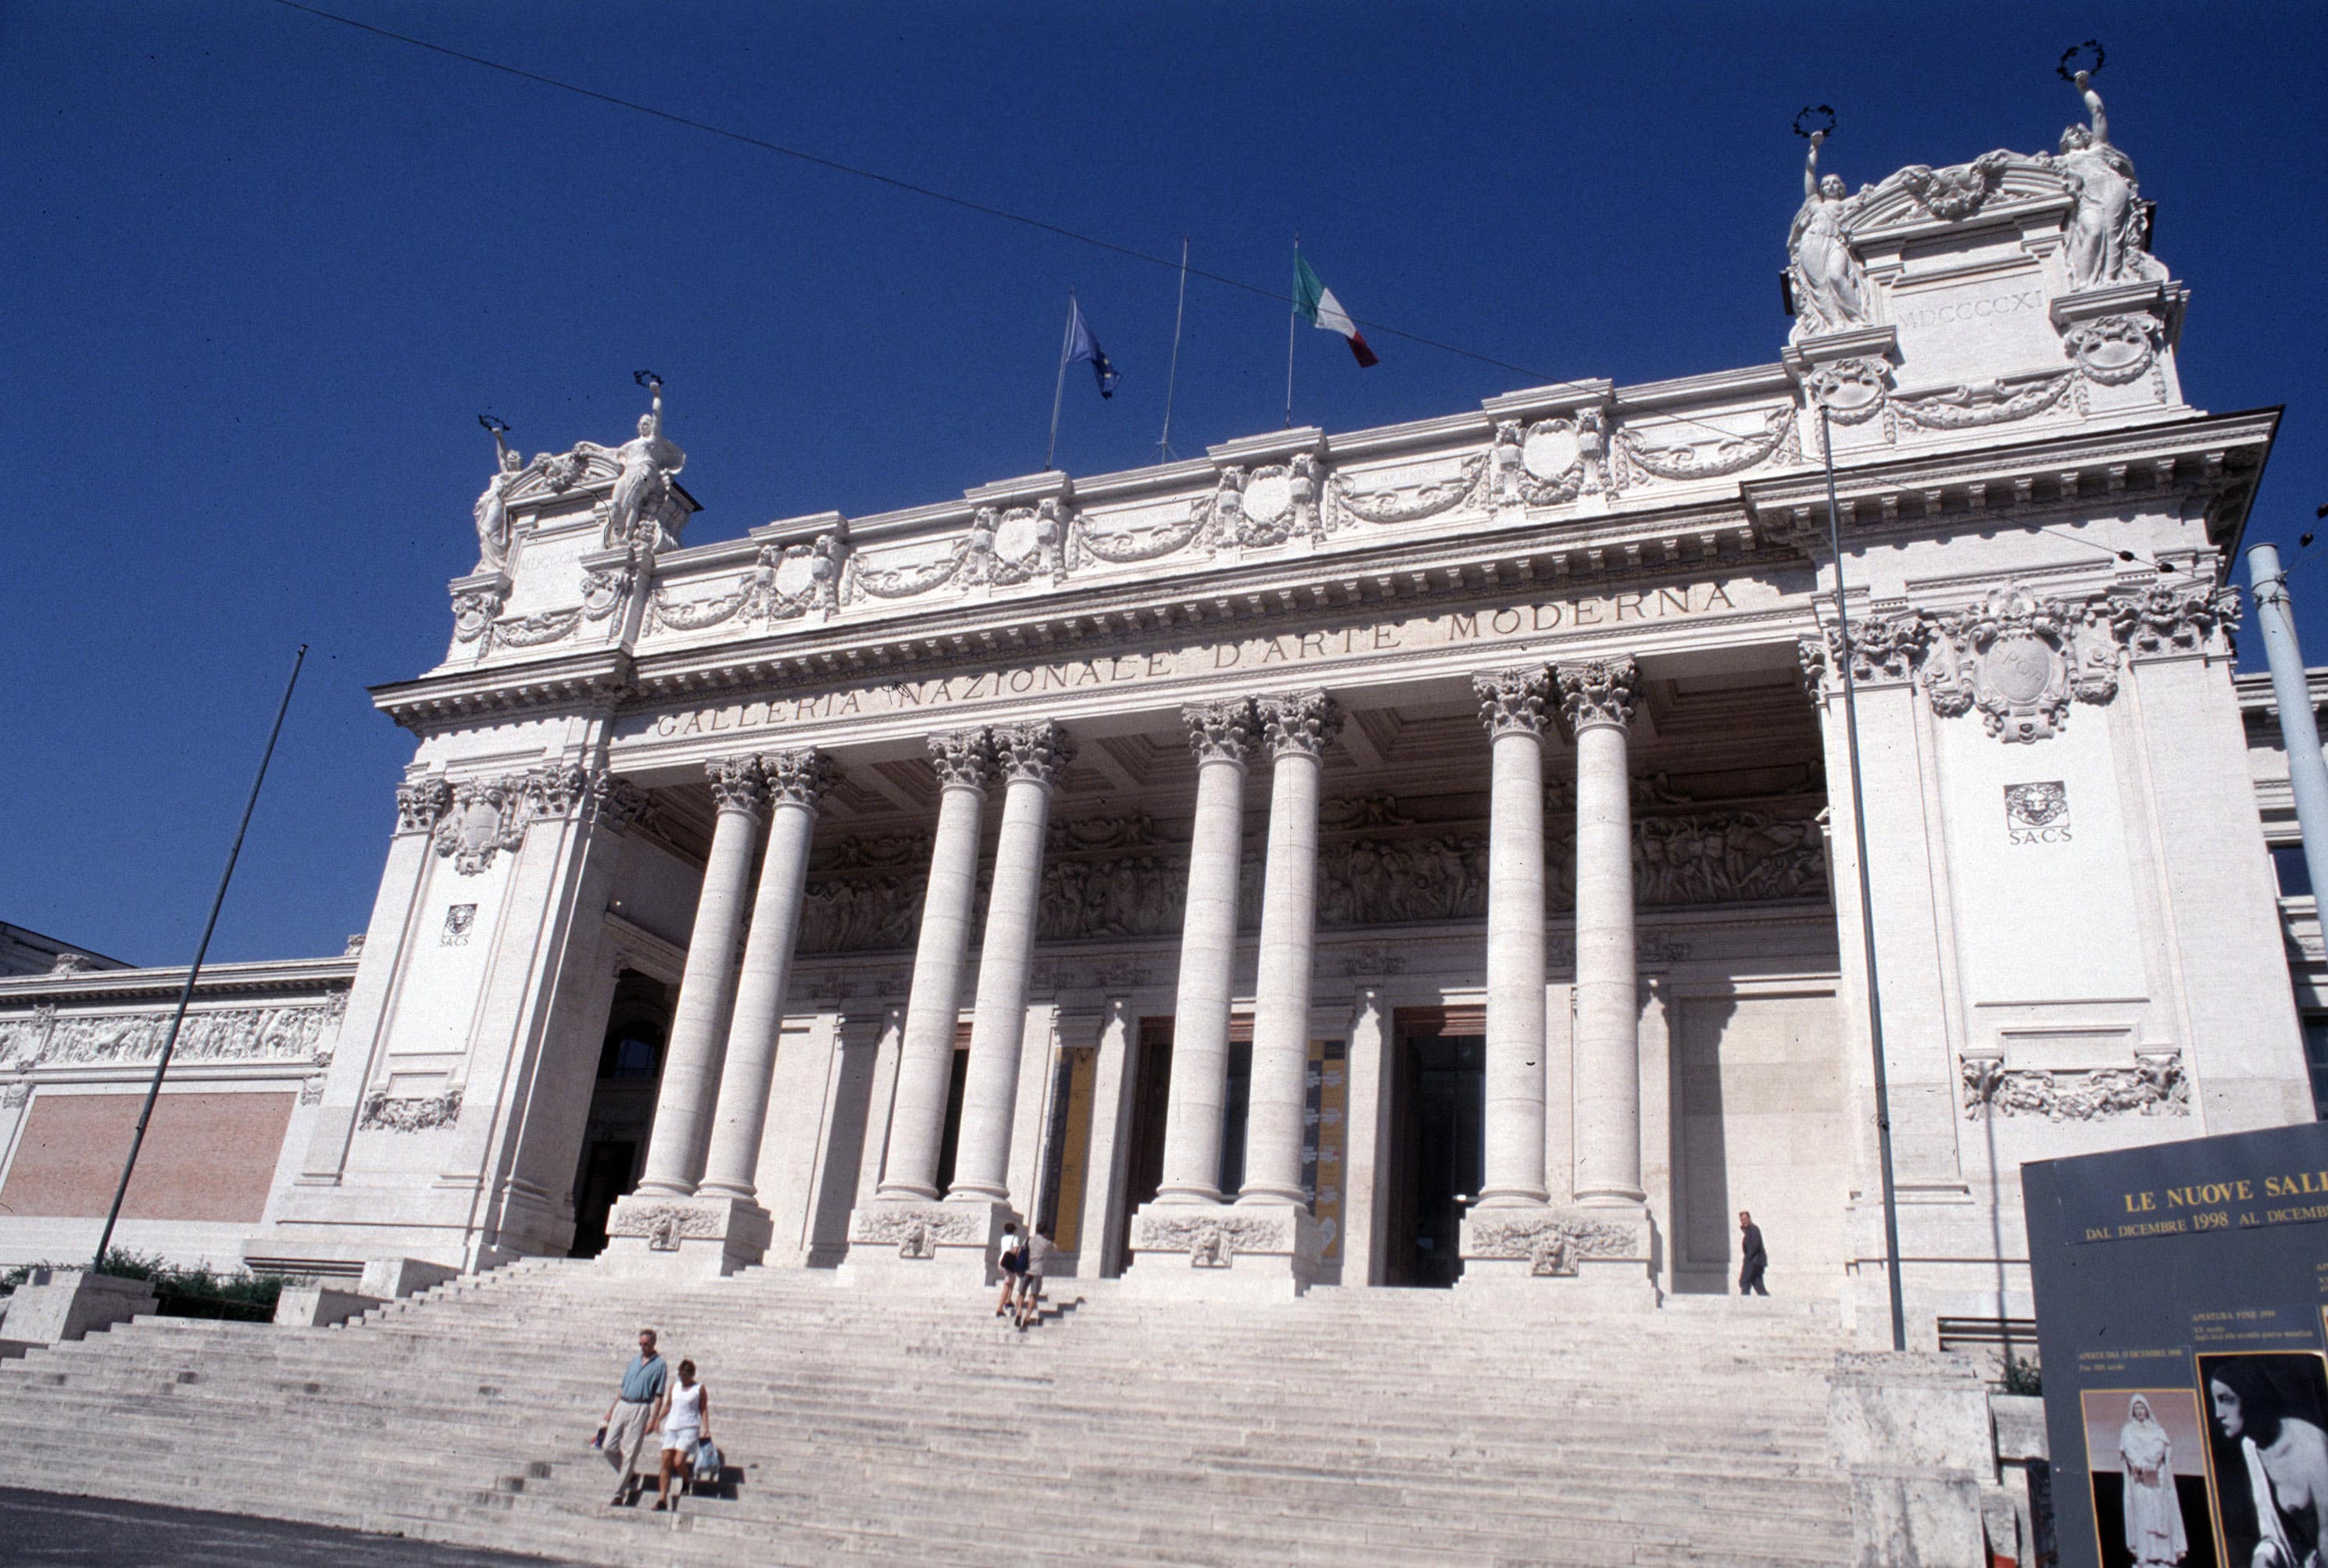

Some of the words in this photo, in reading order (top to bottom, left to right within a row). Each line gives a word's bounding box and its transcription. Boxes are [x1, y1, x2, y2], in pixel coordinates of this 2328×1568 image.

[657, 691, 860, 737] GALLERIA
[899, 650, 1171, 707] NAZIONALE
[1214, 623, 1401, 669] D'ARTE
[1449, 583, 1735, 641] MODERNA
[2124, 1192, 2157, 1213] LE
[2167, 1180, 2254, 1208] NUOVE
[2086, 1227, 2112, 1241] DAL
[2118, 1220, 2187, 1238] DICEMBRE
[2193, 1212, 2229, 1231] 1998
[2239, 1213, 2260, 1226] AL
[2267, 1205, 2328, 1223] DICEMB
